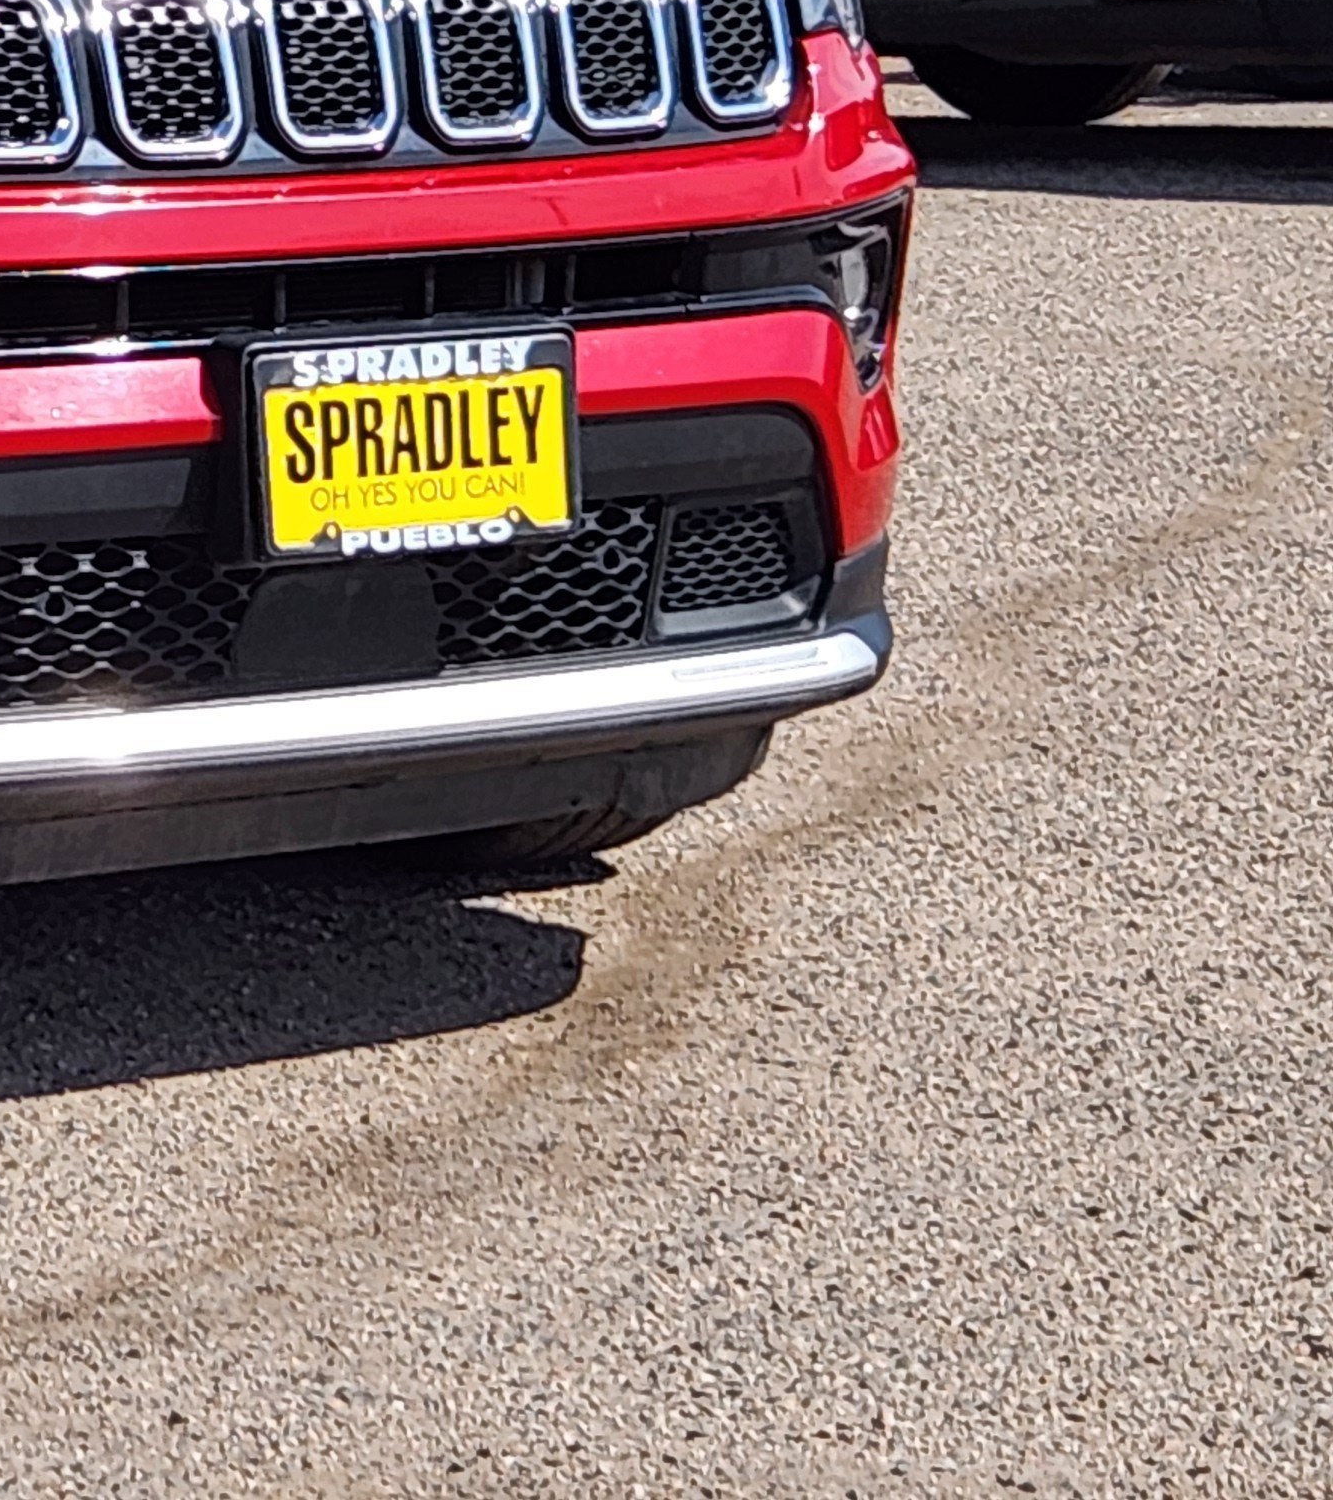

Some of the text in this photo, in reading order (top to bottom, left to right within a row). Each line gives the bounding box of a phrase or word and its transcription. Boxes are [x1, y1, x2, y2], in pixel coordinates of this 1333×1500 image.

[292, 339, 532, 387] SPRADLEY
[283, 384, 545, 484] SPRADLEY
[310, 471, 526, 511] OH YES YOU CAN!
[340, 517, 514, 556] PUEBLO
